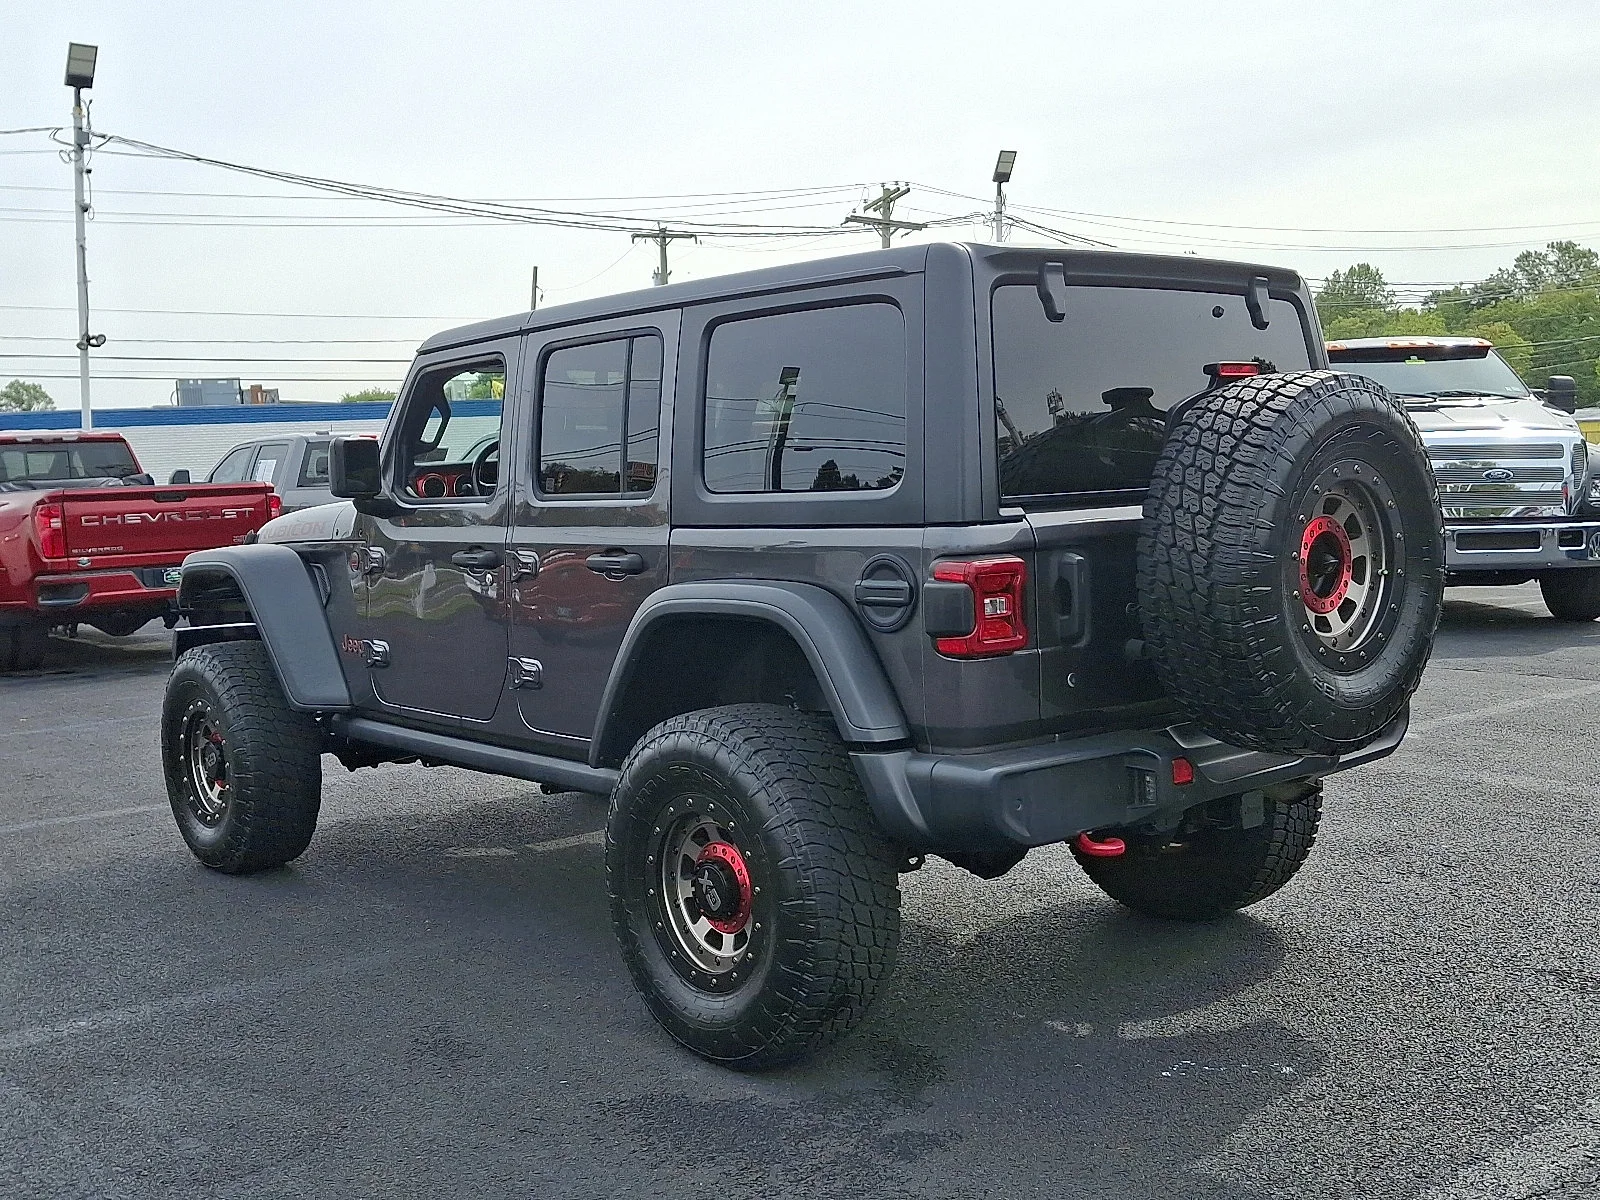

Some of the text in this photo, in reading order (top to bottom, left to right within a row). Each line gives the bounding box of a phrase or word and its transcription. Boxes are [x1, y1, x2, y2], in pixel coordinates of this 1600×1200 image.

[80, 507, 255, 527] CHEVROLET
[262, 521, 326, 540] RUBICON
[71, 545, 124, 554] SILVERADO
[341, 633, 364, 652] Jeep
